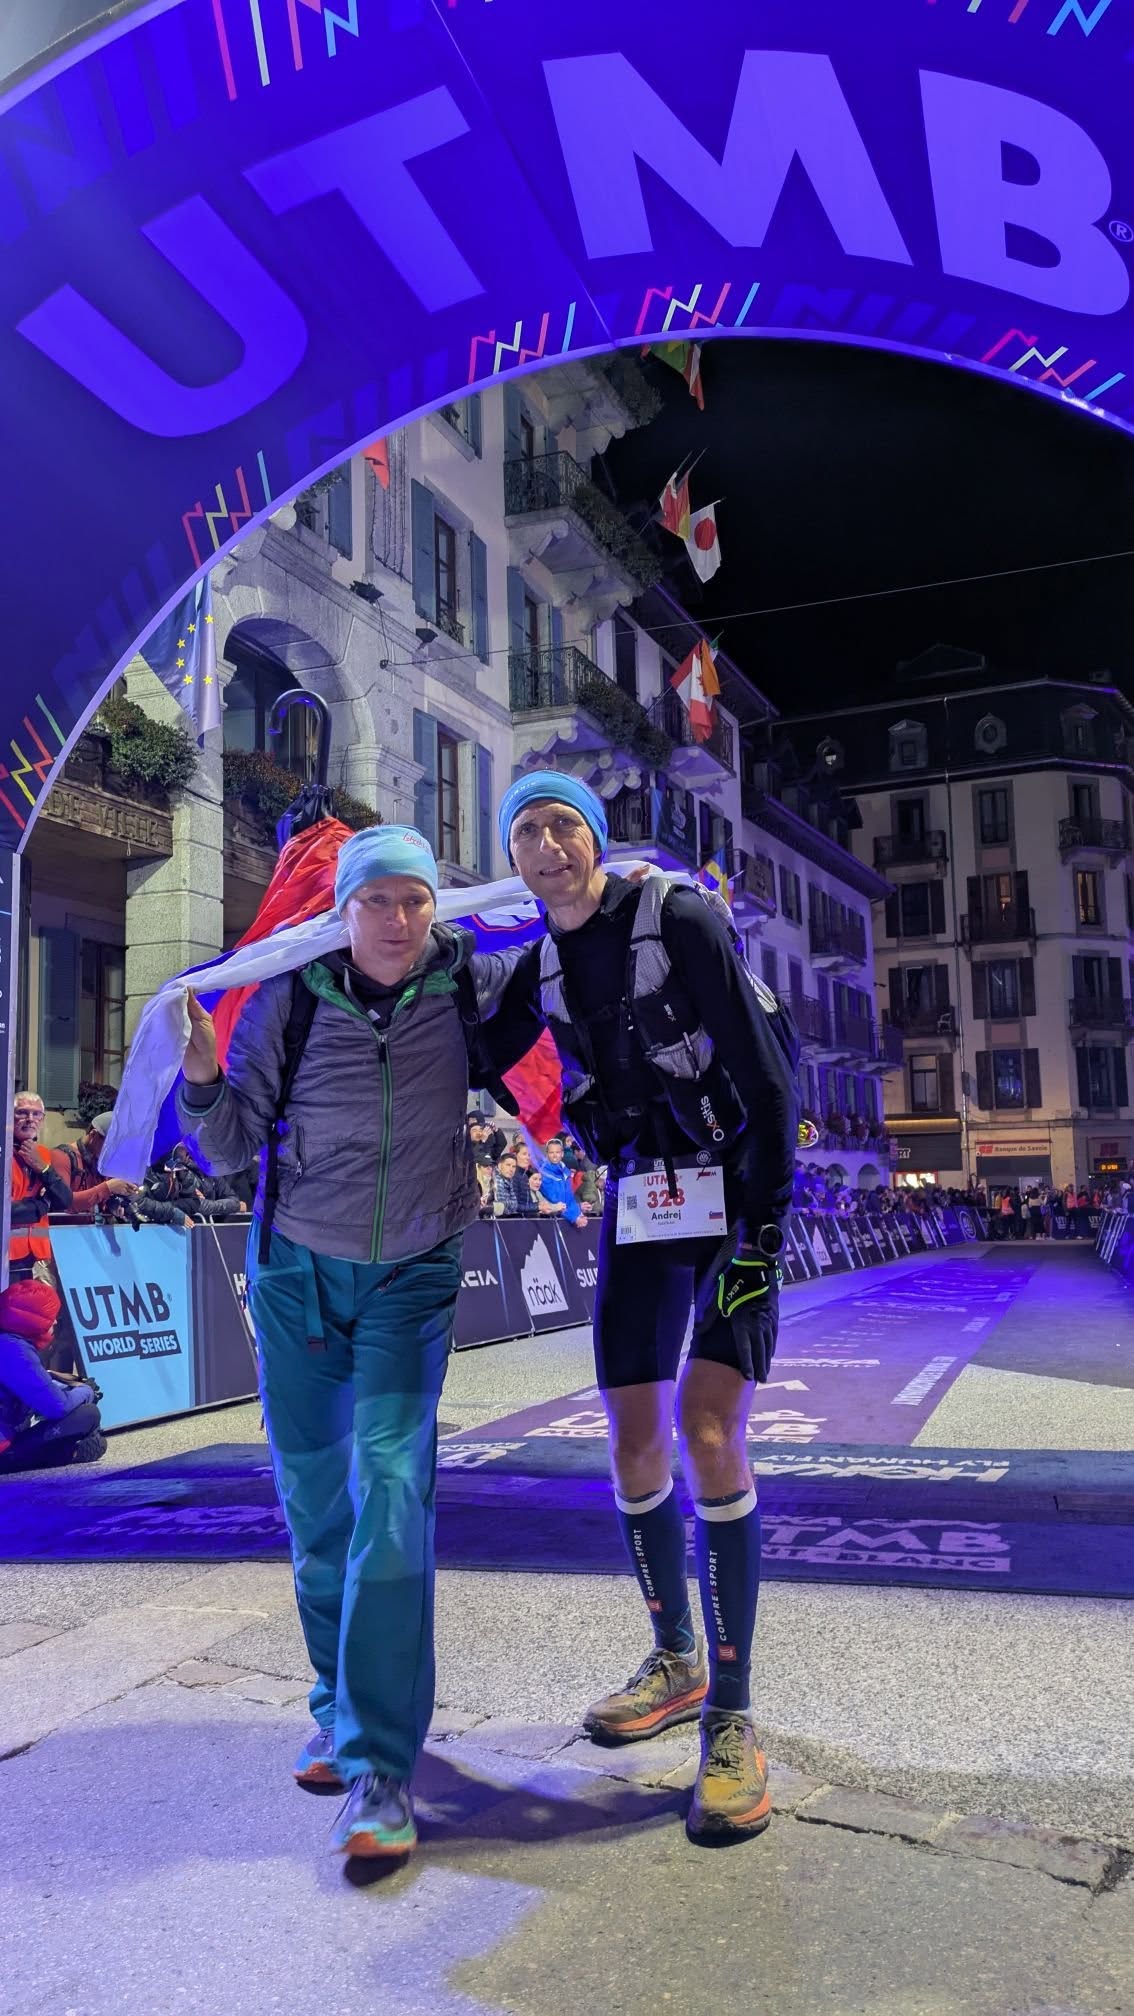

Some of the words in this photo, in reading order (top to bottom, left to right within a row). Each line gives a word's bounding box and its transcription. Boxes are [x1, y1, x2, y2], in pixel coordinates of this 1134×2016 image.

[647, 1188, 686, 1209] 328
[651, 1210, 682, 1221] Andrej
[461, 1269, 498, 1288] CIA
[725, 1278, 745, 1302] LEKI
[88, 1336, 137, 1357] WORLD
[139, 1335, 178, 1355] SERIES
[819, 1456, 950, 1465] HUMAN
[753, 1462, 1010, 1483] HOKA
[684, 1523, 1013, 1554] TMB
[709, 1550, 727, 1642] COMPRESSPORT
